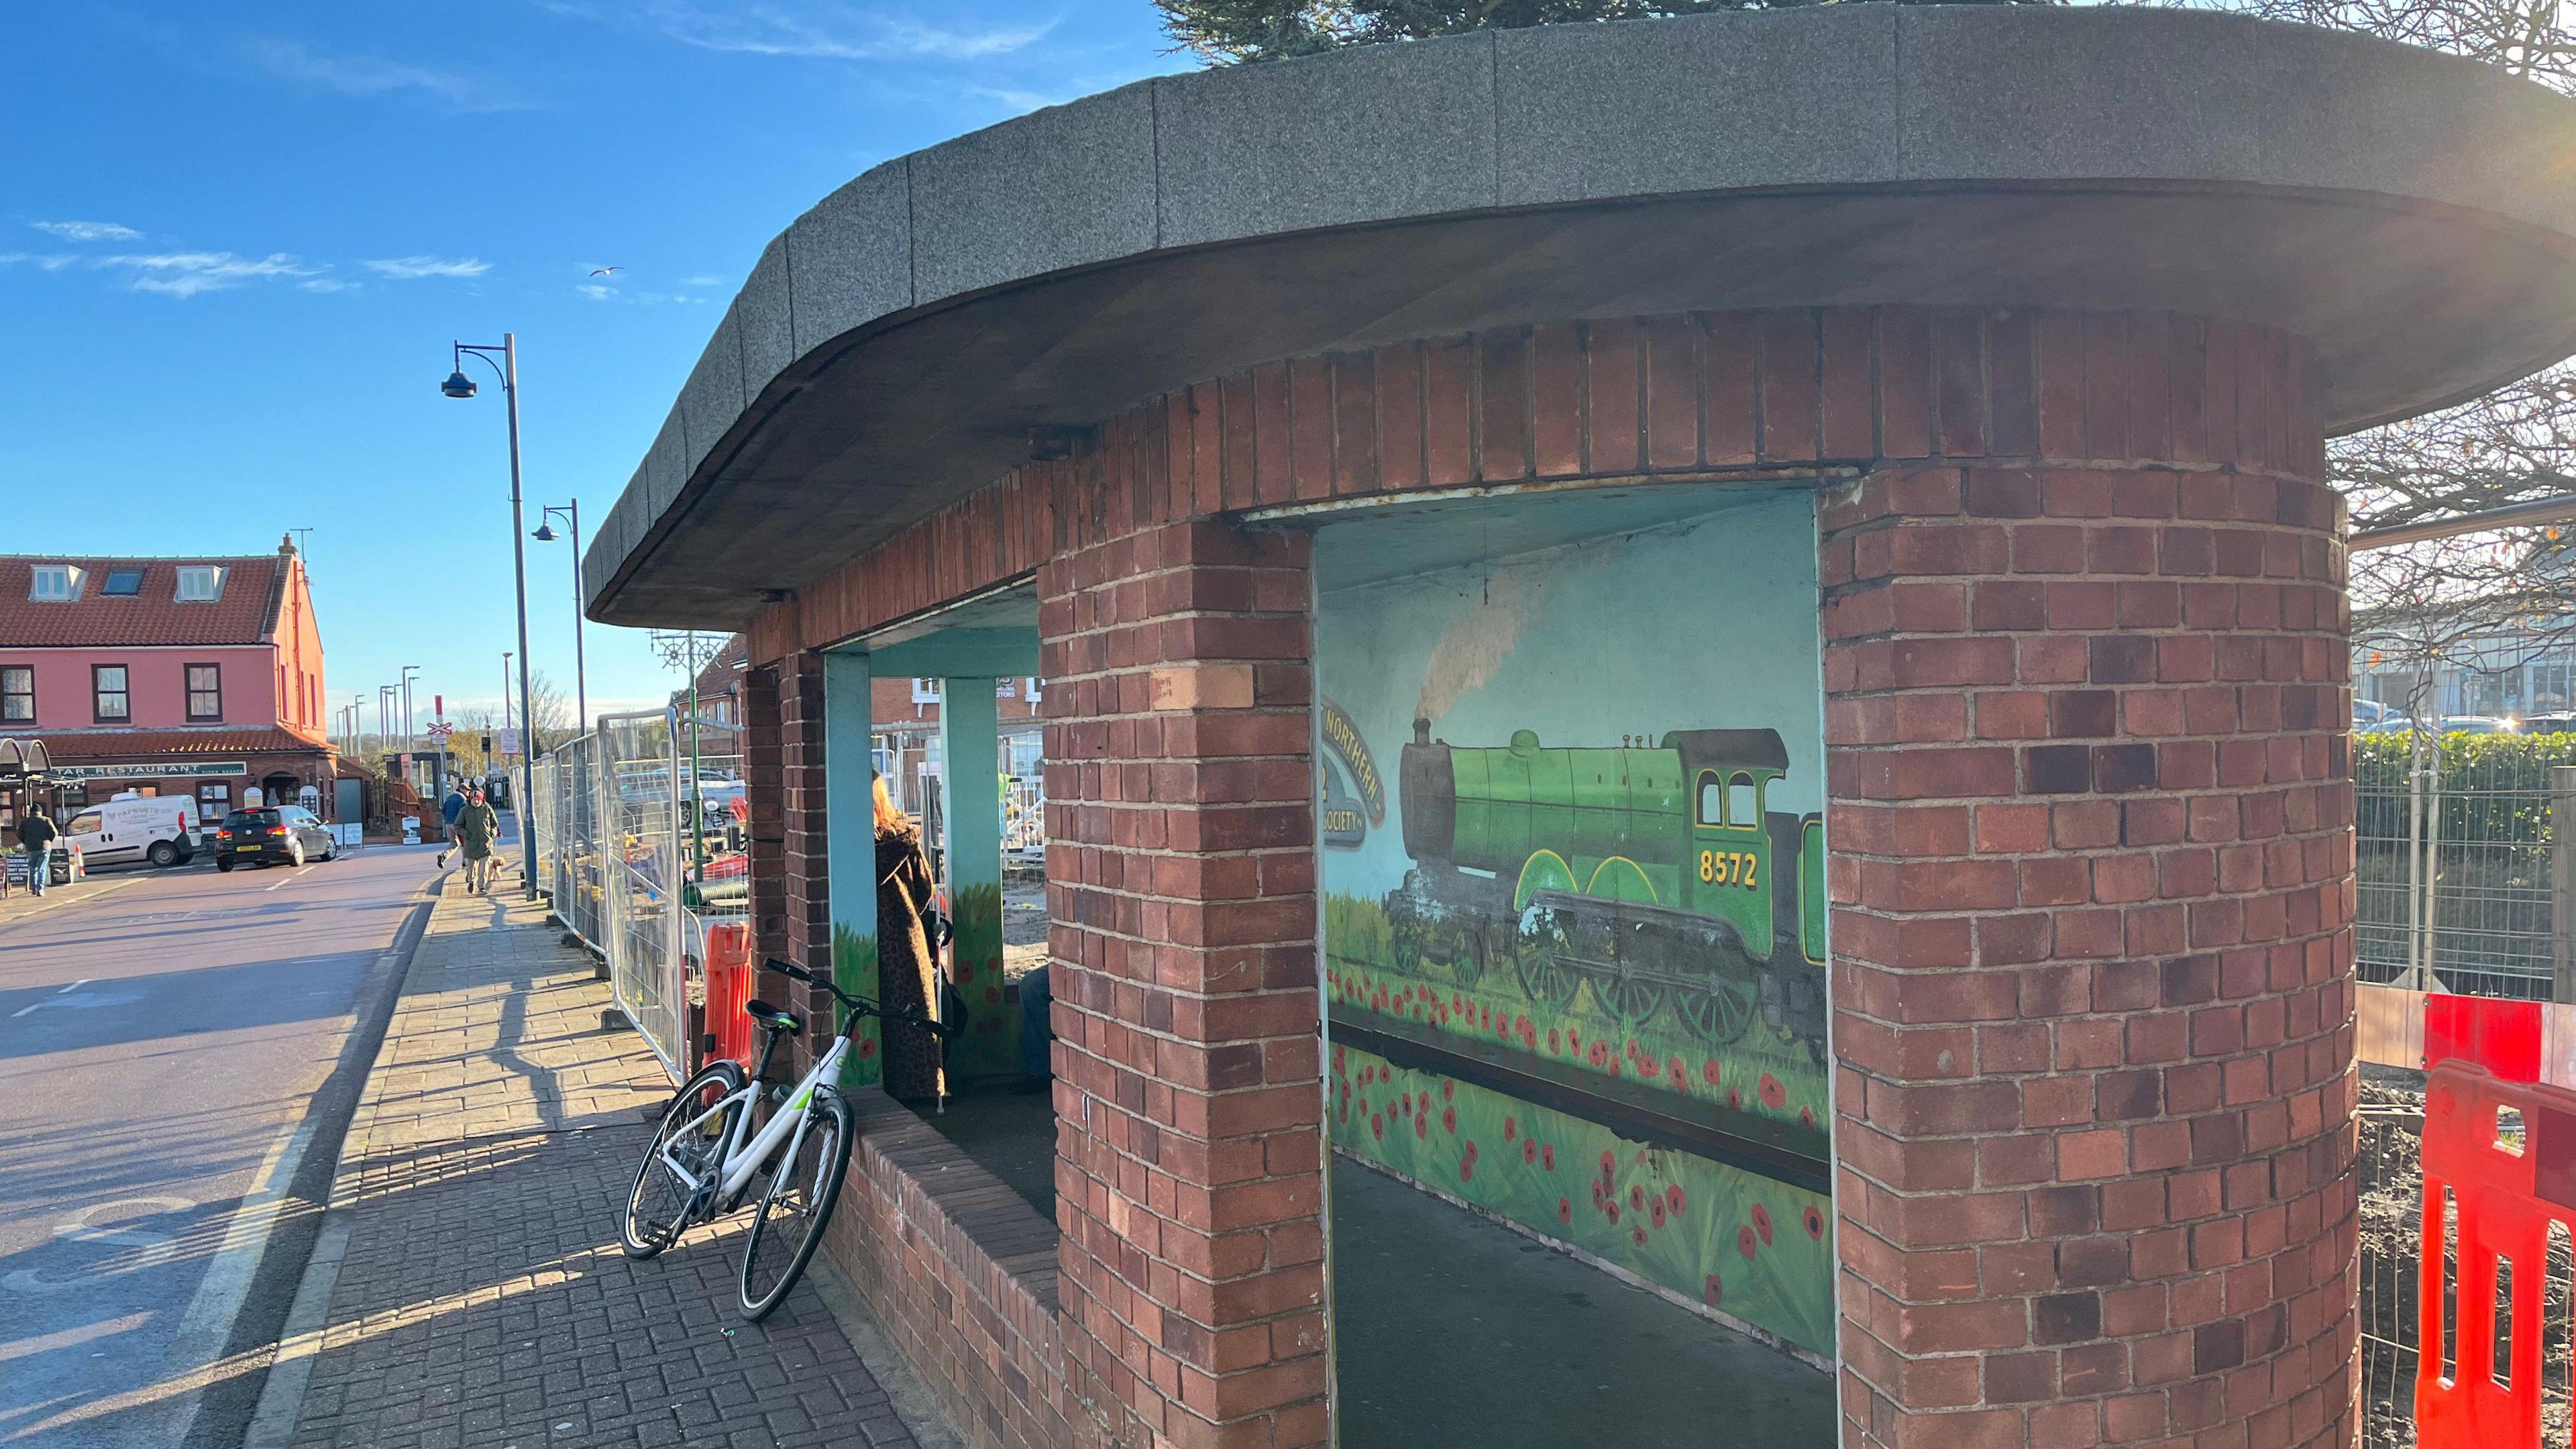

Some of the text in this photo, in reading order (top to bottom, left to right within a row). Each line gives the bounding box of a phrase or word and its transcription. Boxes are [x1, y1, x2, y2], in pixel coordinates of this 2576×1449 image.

[95, 765, 199, 774] RESTAURANT
[117, 806, 160, 818] PAPWORTH
[1700, 849, 1757, 889] 8572
